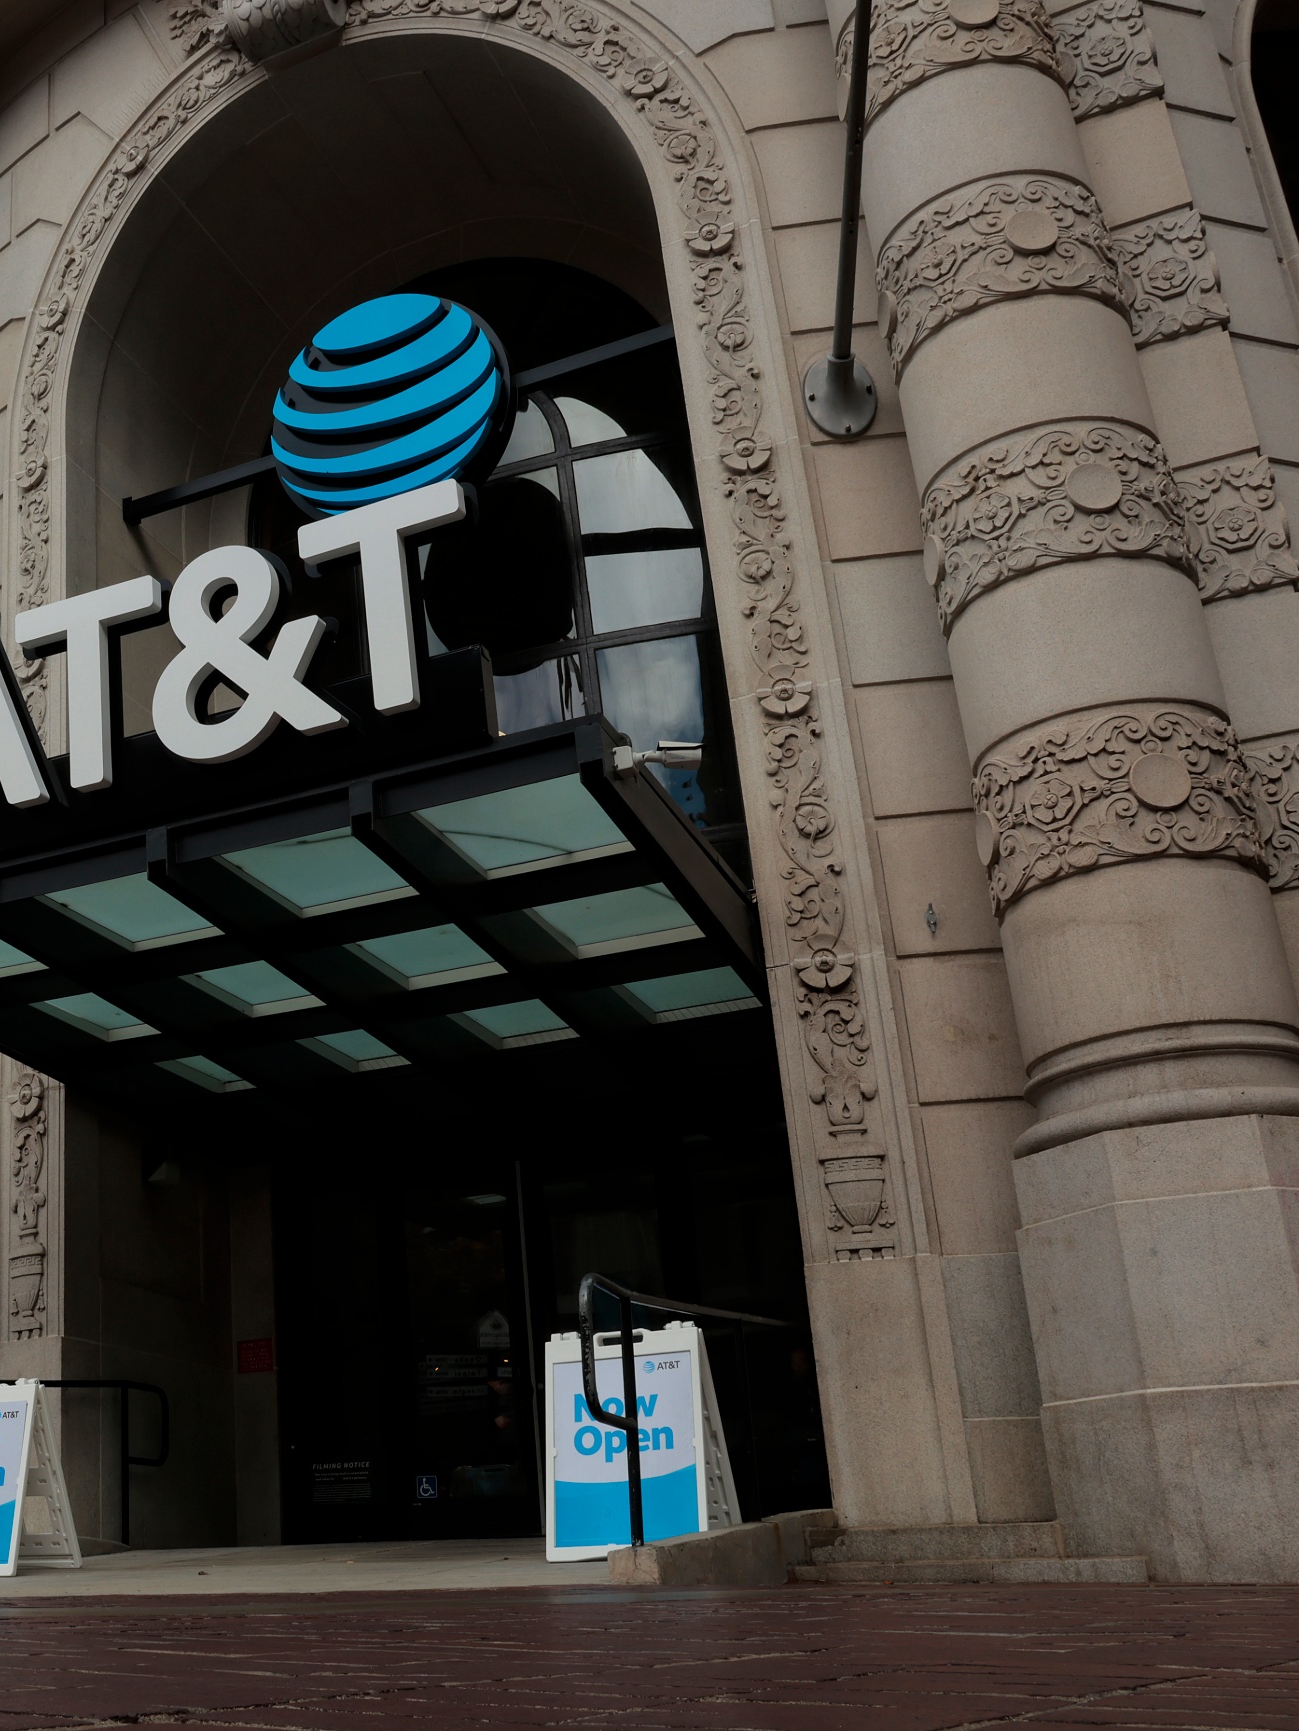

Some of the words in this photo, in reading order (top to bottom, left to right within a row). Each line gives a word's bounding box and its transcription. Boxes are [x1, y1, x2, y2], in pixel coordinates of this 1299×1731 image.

[657, 1359, 680, 1371] AT&T
[574, 1393, 658, 1423] Now
[2, 1411, 19, 1419] AT&T
[574, 1425, 674, 1463] Open
[343, 1461, 370, 1469] NOTICE
